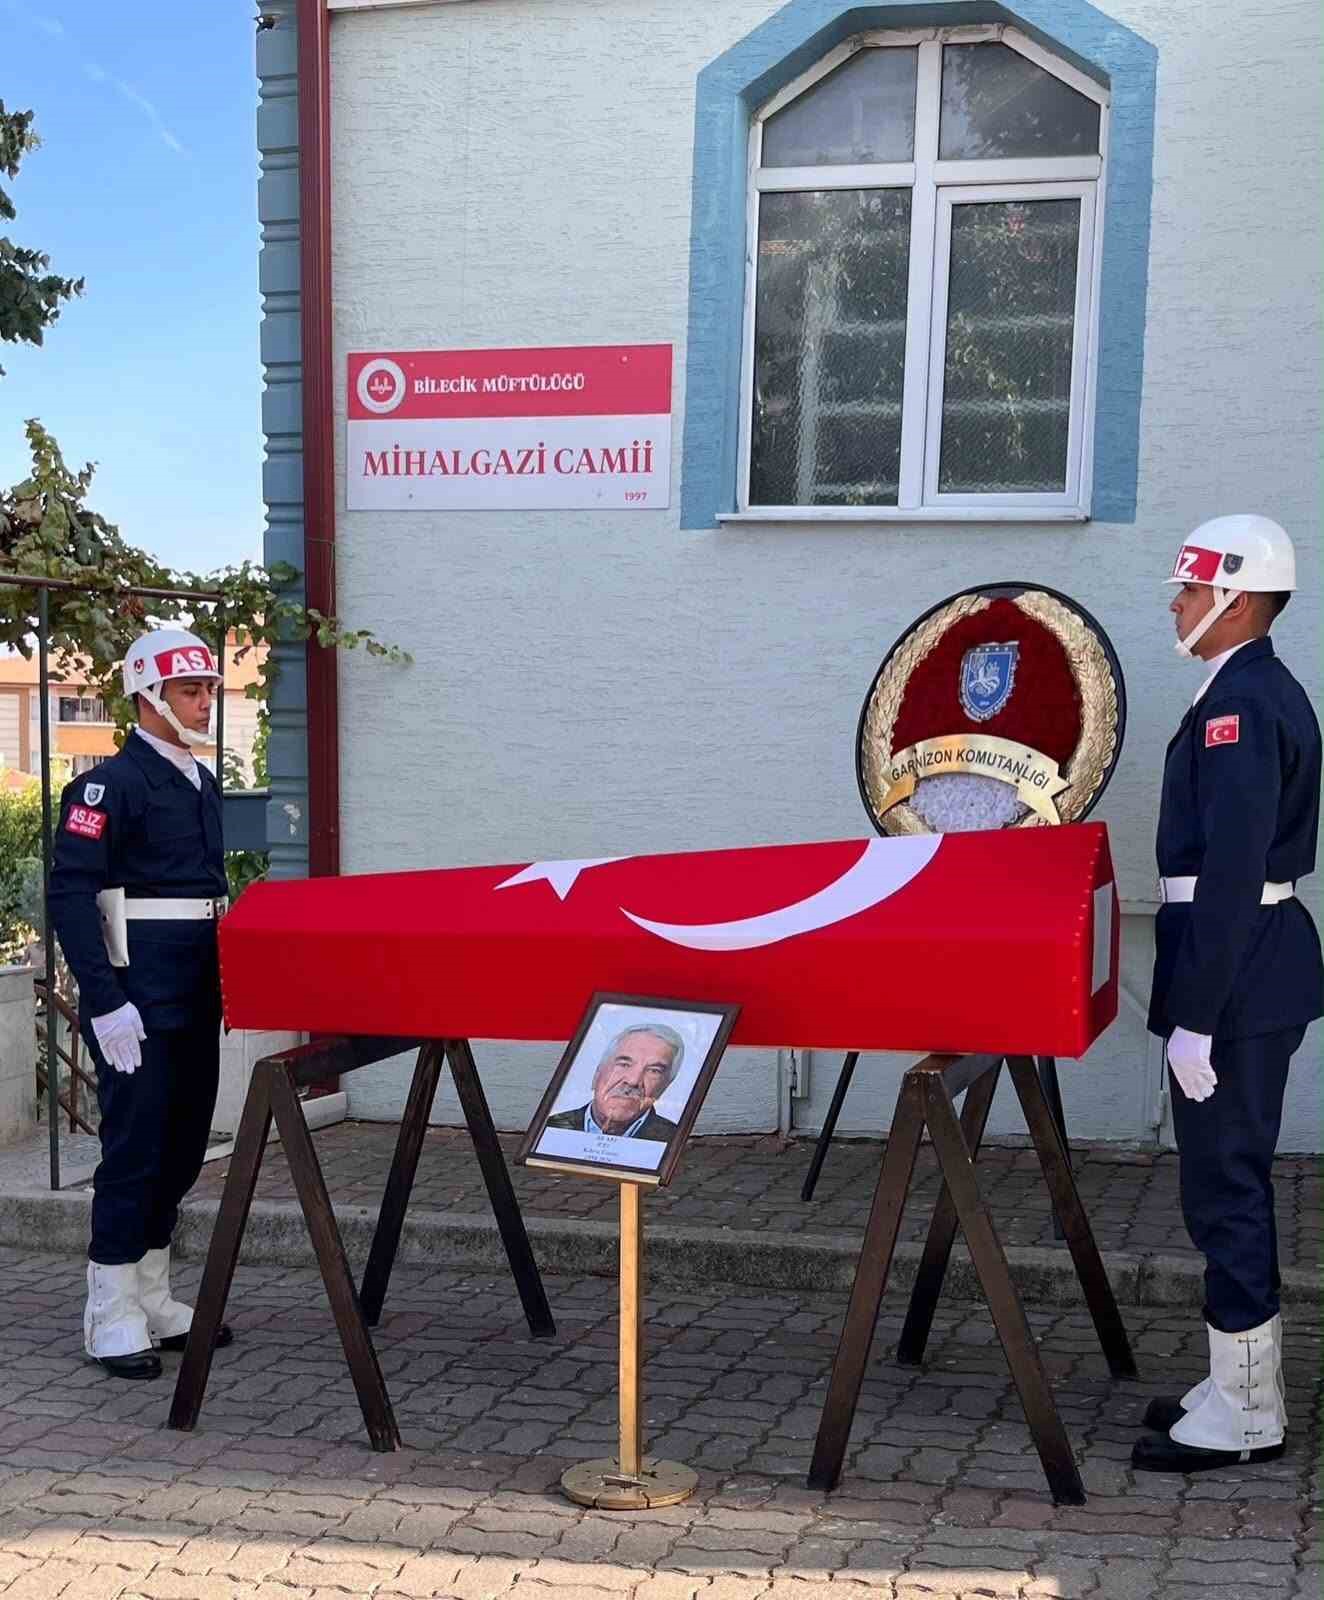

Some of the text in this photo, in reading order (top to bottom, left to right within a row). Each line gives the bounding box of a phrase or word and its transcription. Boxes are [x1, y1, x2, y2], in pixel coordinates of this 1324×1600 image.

[413, 373, 584, 393] BİLECİK MÜFTÜLÜĞÜ
[363, 440, 654, 477] MİHALGAZİ CAMİİ
[624, 491, 647, 501] 1997
[891, 749, 1050, 790] GARNİZON KOMUTANLIĞI
